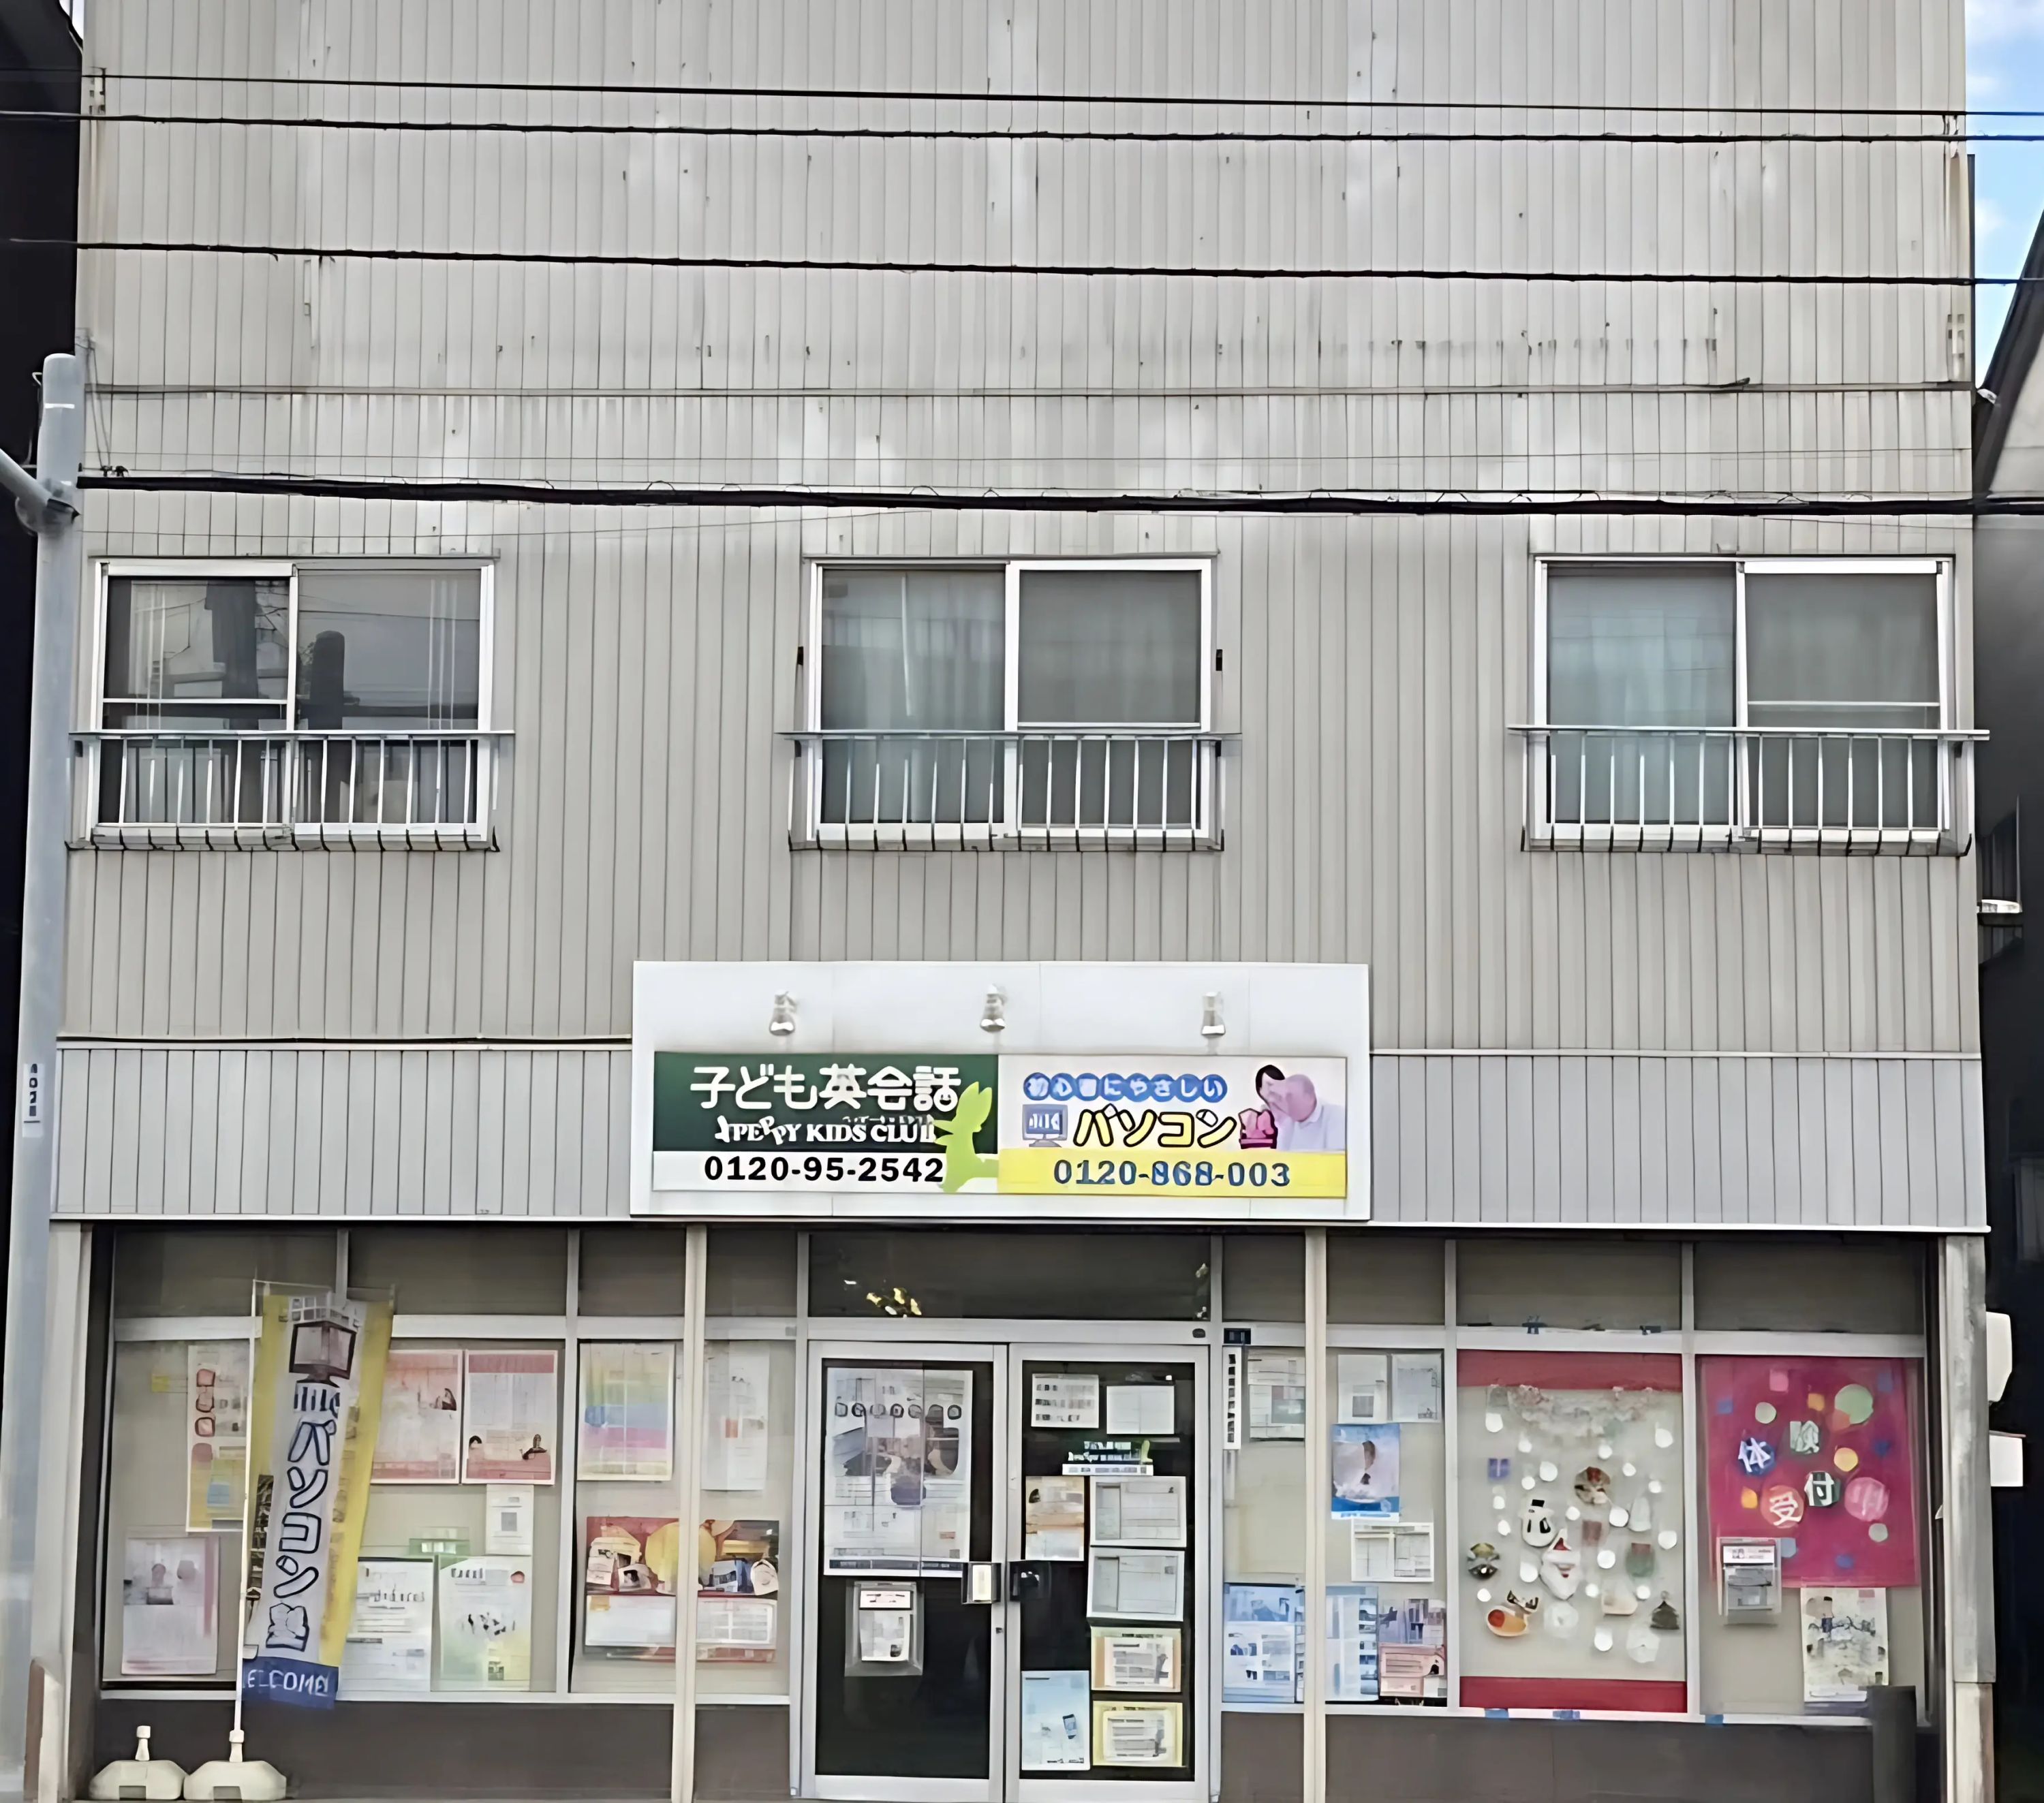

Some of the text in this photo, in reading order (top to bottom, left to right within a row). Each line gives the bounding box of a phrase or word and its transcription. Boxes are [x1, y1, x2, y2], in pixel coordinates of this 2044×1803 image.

[690, 1063, 961, 1112] 子ども英会話
[1026, 1076, 1224, 1097] 初心にやさしい
[729, 1116, 802, 1145] PEPPY
[806, 1124, 867, 1142] KIDS
[704, 1156, 944, 1182] 0120-95-2542
[1053, 1159, 1290, 1187] 0120-868-003
